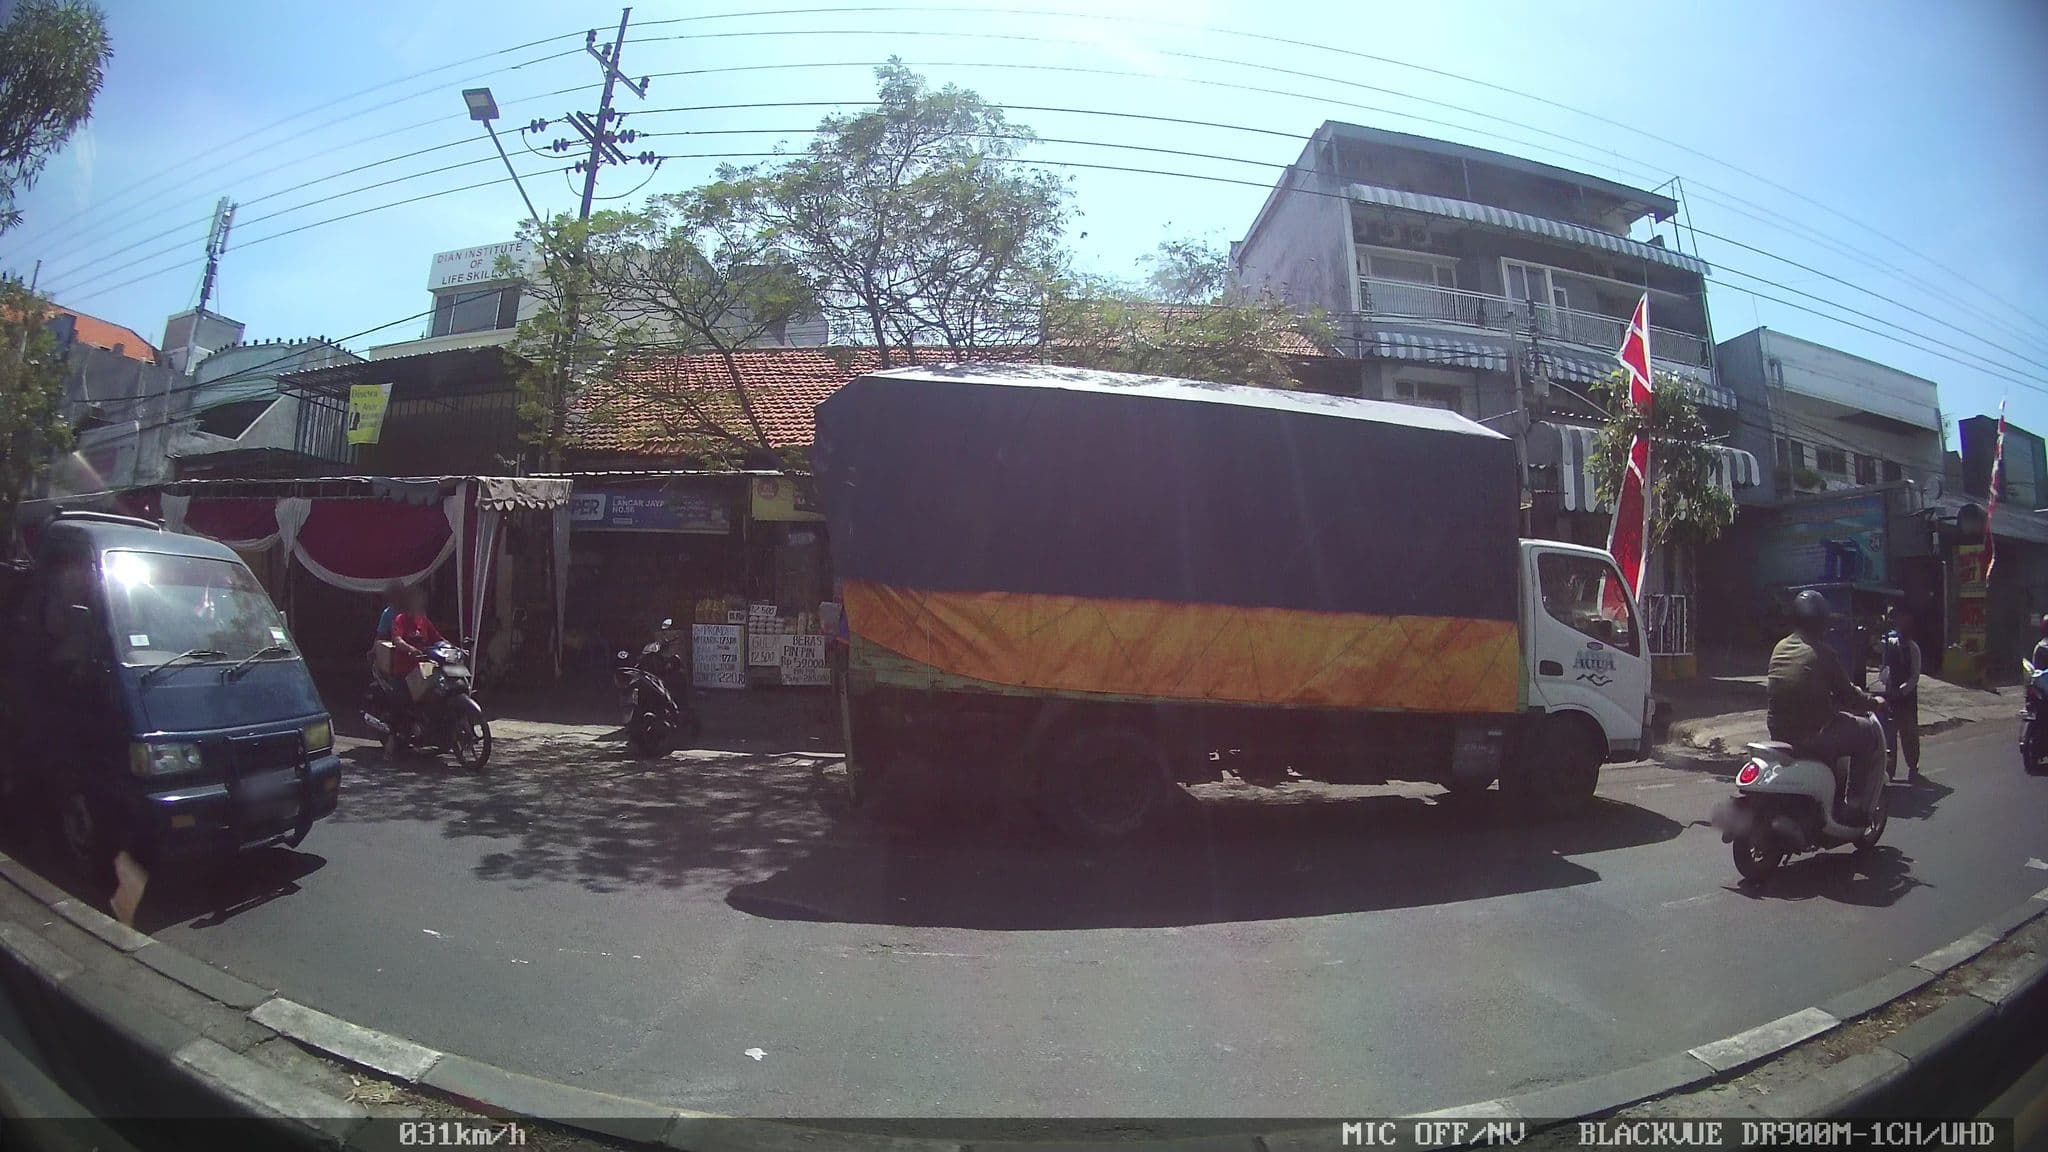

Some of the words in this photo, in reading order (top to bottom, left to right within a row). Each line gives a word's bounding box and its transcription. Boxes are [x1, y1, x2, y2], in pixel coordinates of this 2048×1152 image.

[437, 252, 461, 264] DIAN
[465, 242, 523, 259] INSTITUTE
[470, 259, 482, 269] OF
[442, 273, 464, 285] LIFE
[612, 499, 643, 507] LANCAR
[793, 635, 822, 646] BERAS
